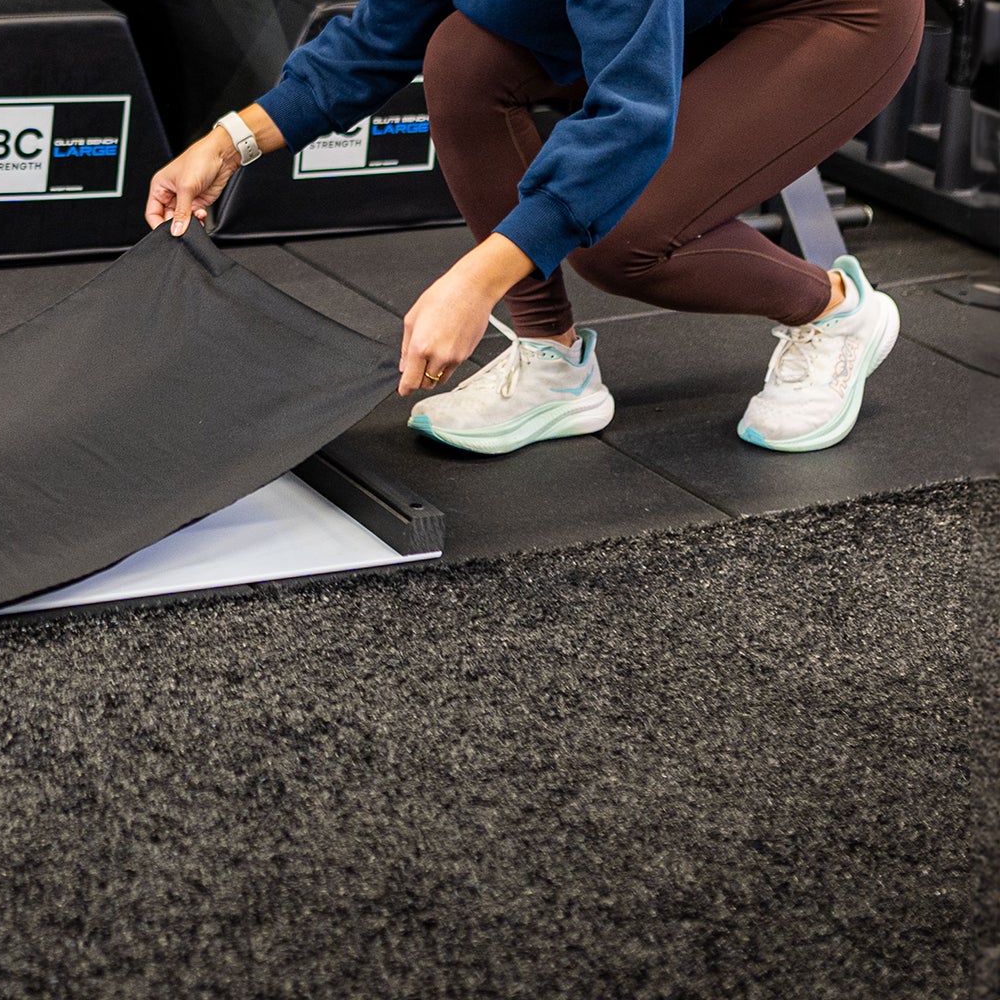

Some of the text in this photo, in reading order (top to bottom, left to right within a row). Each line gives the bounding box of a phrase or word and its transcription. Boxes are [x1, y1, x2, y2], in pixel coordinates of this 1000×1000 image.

[371, 122, 429, 136] LARGE
[53, 145, 118, 158] LARGE
[309, 140, 362, 150] STRENGTH
